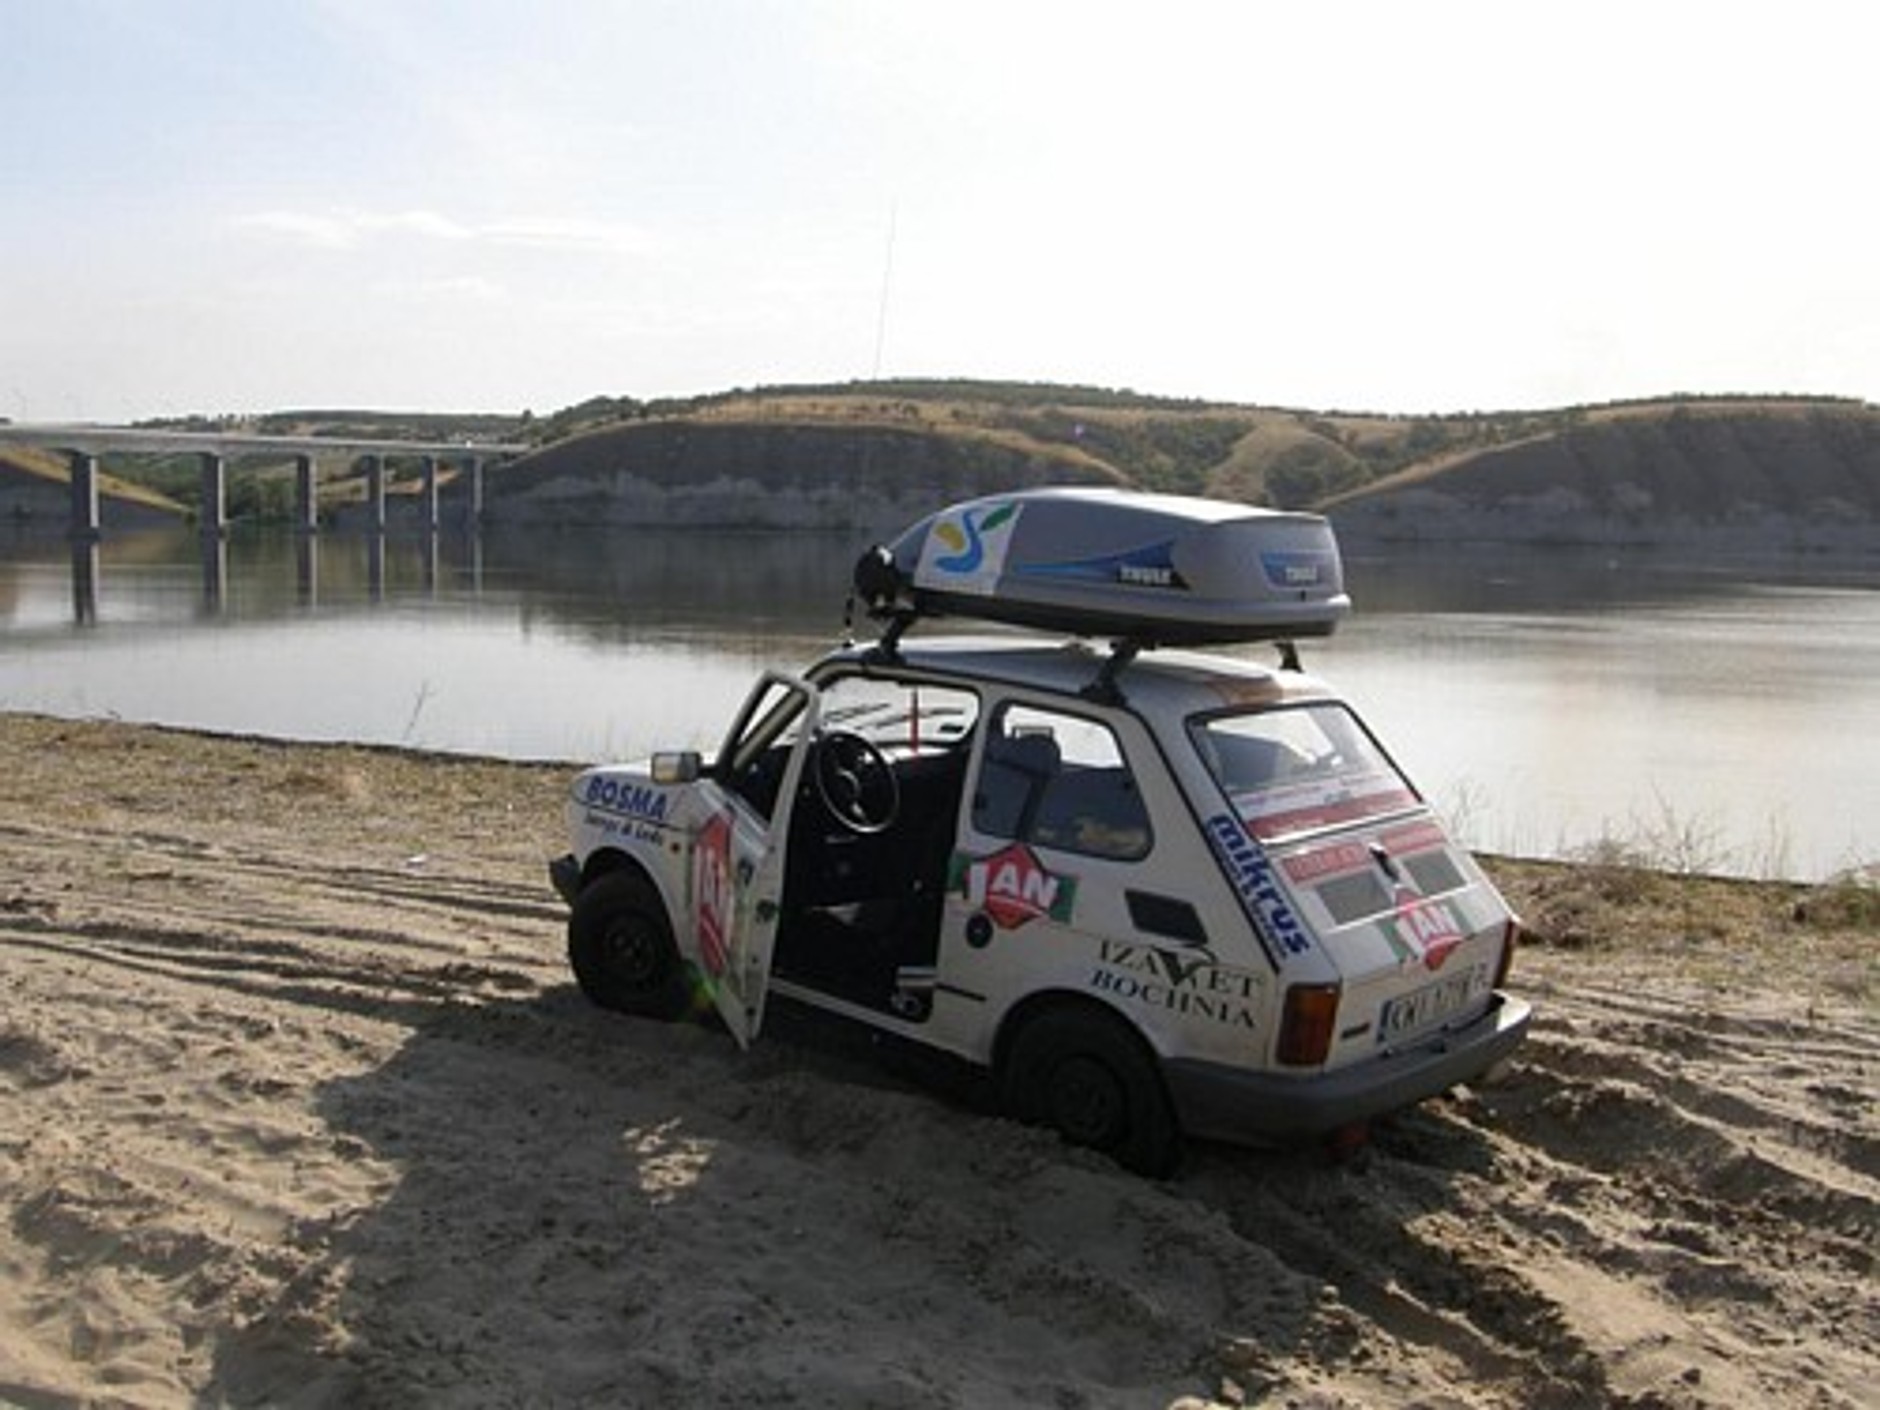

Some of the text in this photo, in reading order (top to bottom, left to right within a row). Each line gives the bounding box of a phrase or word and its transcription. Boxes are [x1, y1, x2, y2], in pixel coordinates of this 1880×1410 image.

[586, 776, 667, 820] BOSMA
[1206, 814, 1311, 954] mikrus
[1091, 969, 1255, 1029] BOCHNIA
